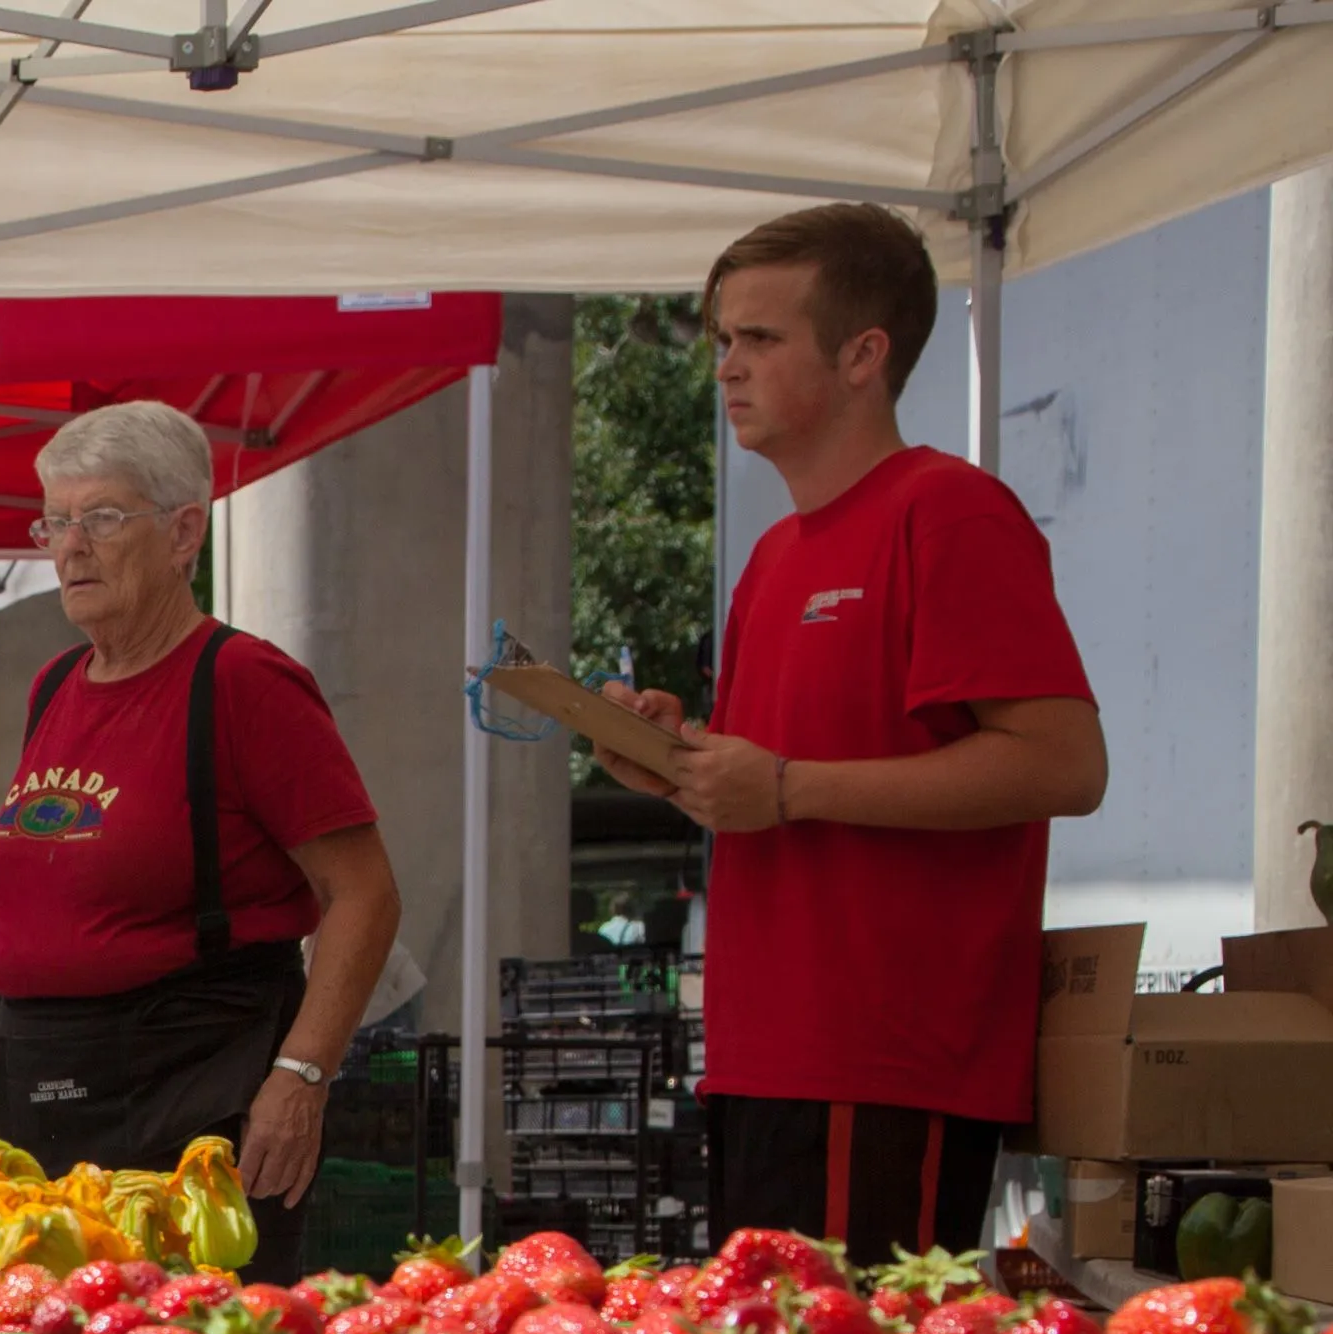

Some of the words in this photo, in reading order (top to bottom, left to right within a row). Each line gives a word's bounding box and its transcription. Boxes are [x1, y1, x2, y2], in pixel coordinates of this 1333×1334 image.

[4, 766, 120, 810] CANADA
[1144, 1050, 1151, 1064] 1
[1156, 1049, 1189, 1065] DOZ.
